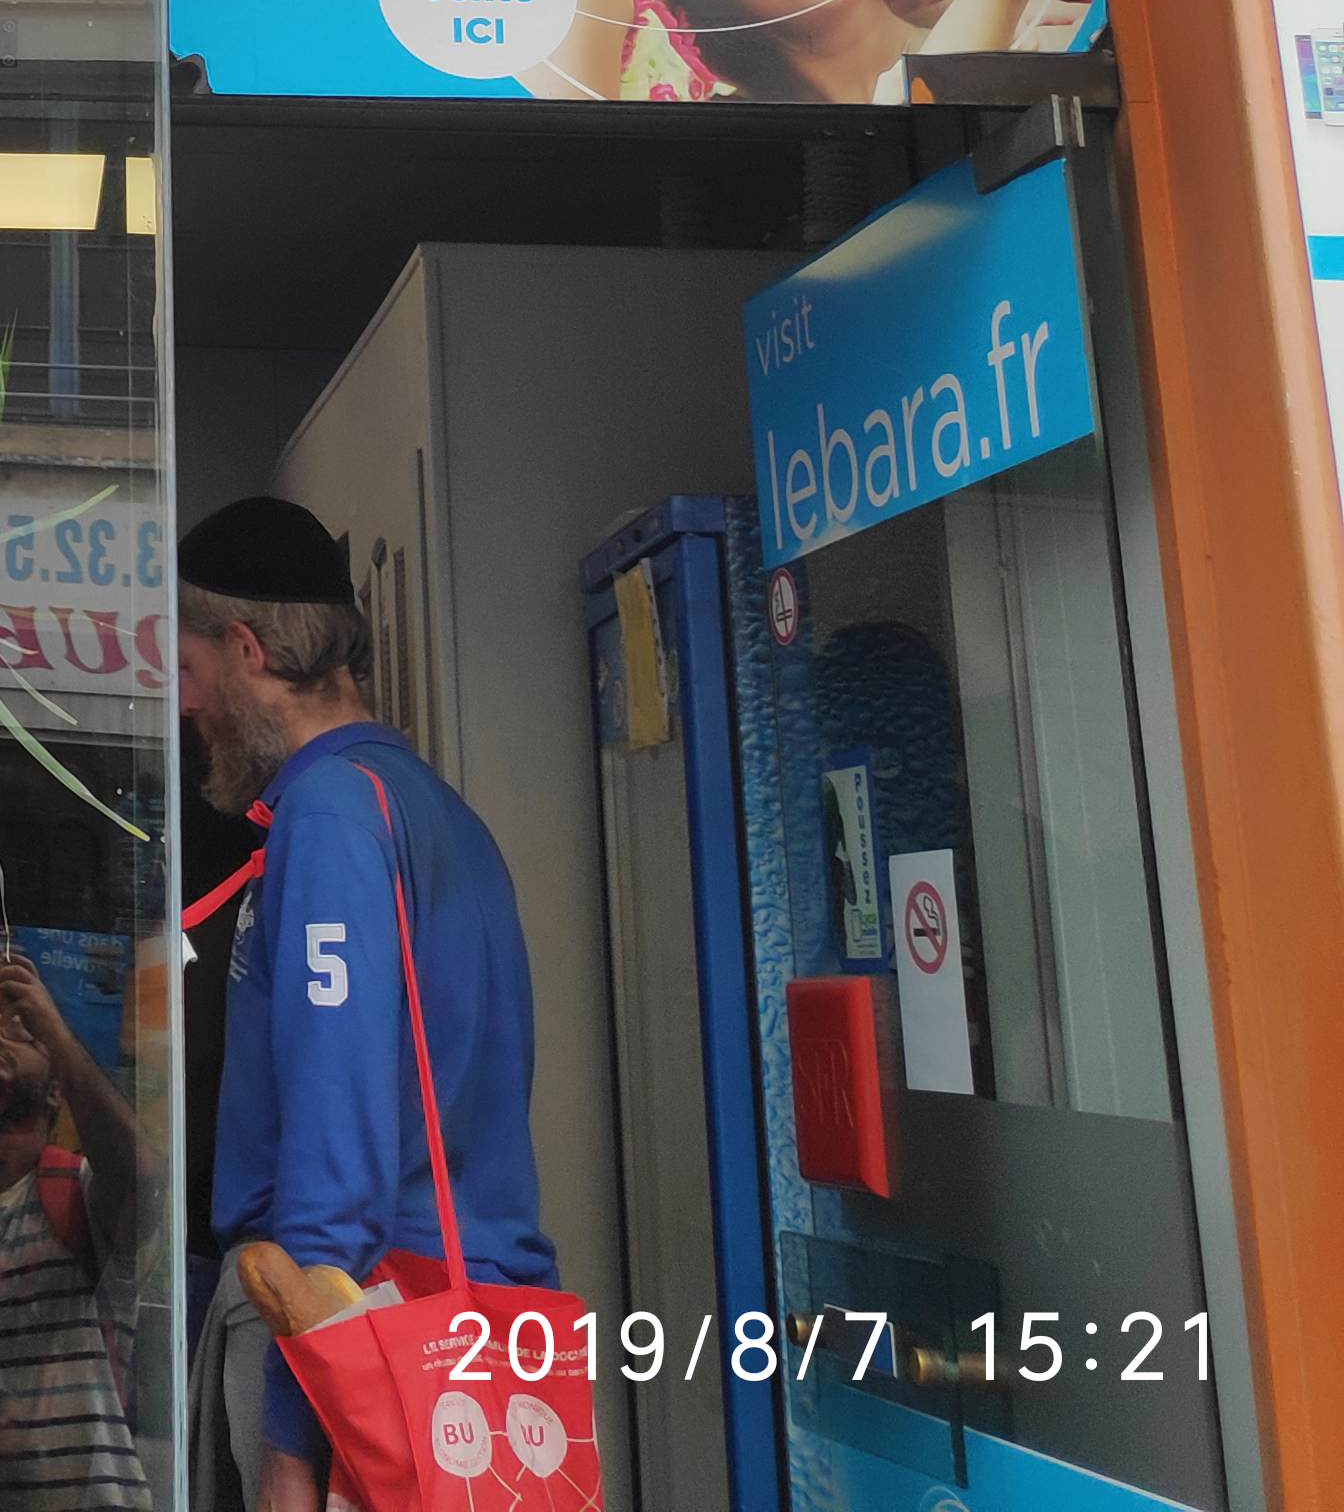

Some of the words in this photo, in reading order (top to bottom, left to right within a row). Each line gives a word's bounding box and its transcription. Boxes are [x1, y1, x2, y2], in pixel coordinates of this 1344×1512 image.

[452, 17, 505, 45] ICI
[754, 296, 815, 376] visit
[767, 300, 1049, 551] lebara.fr
[305, 922, 349, 1007] 5
